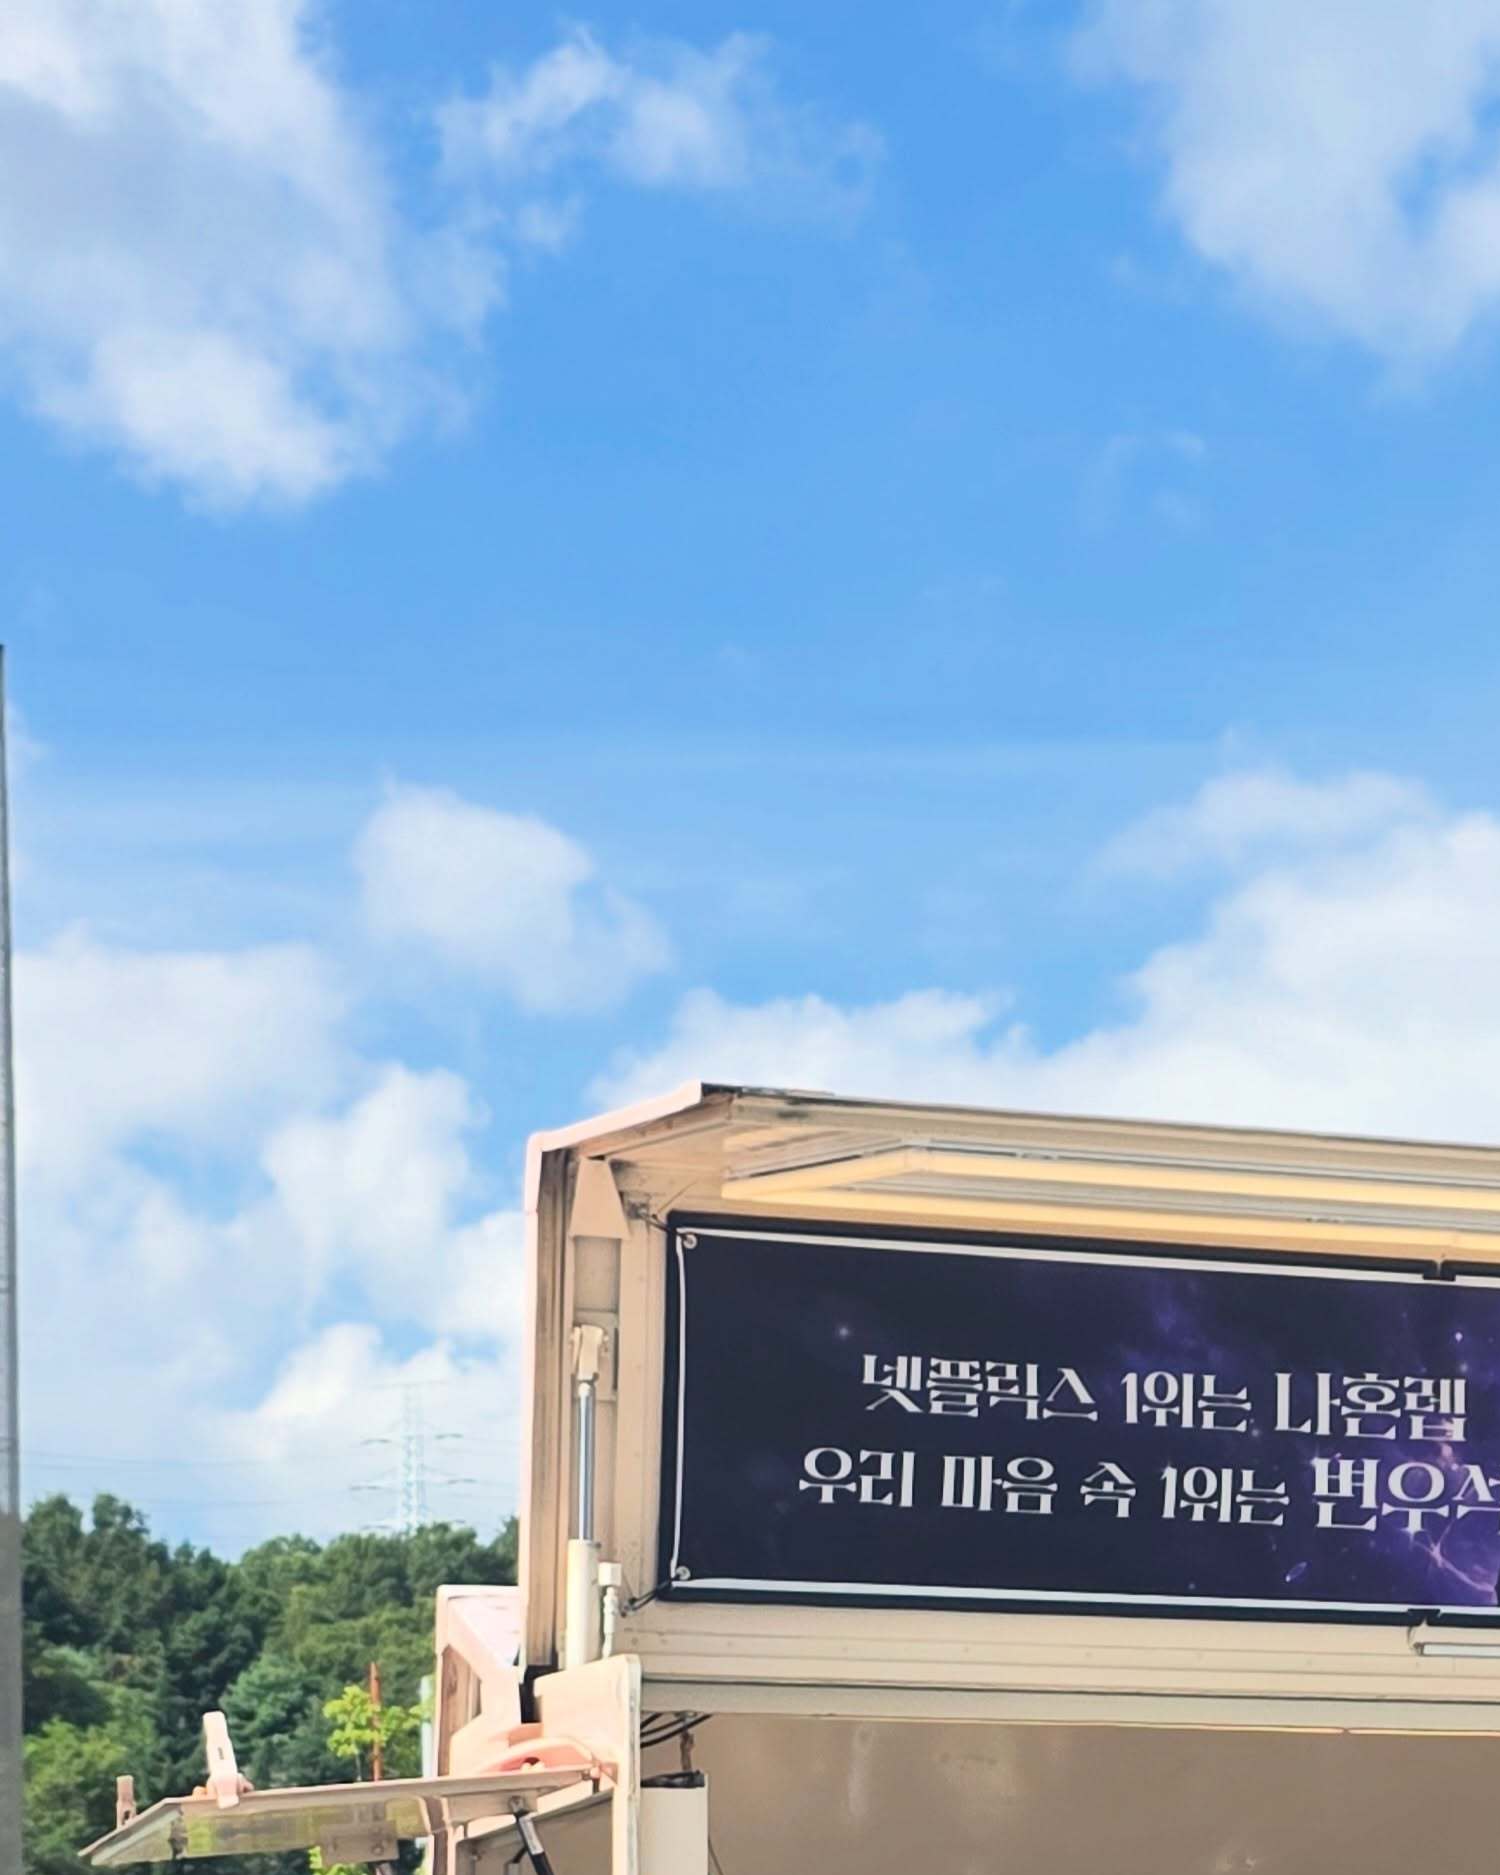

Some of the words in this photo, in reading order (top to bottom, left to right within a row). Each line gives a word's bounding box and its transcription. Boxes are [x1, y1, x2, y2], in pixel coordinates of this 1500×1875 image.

[862, 1354, 1098, 1421] 넷플릭스
[1121, 1371, 1252, 1433] 1위는
[1274, 1372, 1467, 1442] 나혼렙
[799, 1447, 916, 1508] 우리
[941, 1456, 1058, 1514] 마음
[1080, 1461, 1137, 1518] 속
[1160, 1464, 1290, 1526] 1위는
